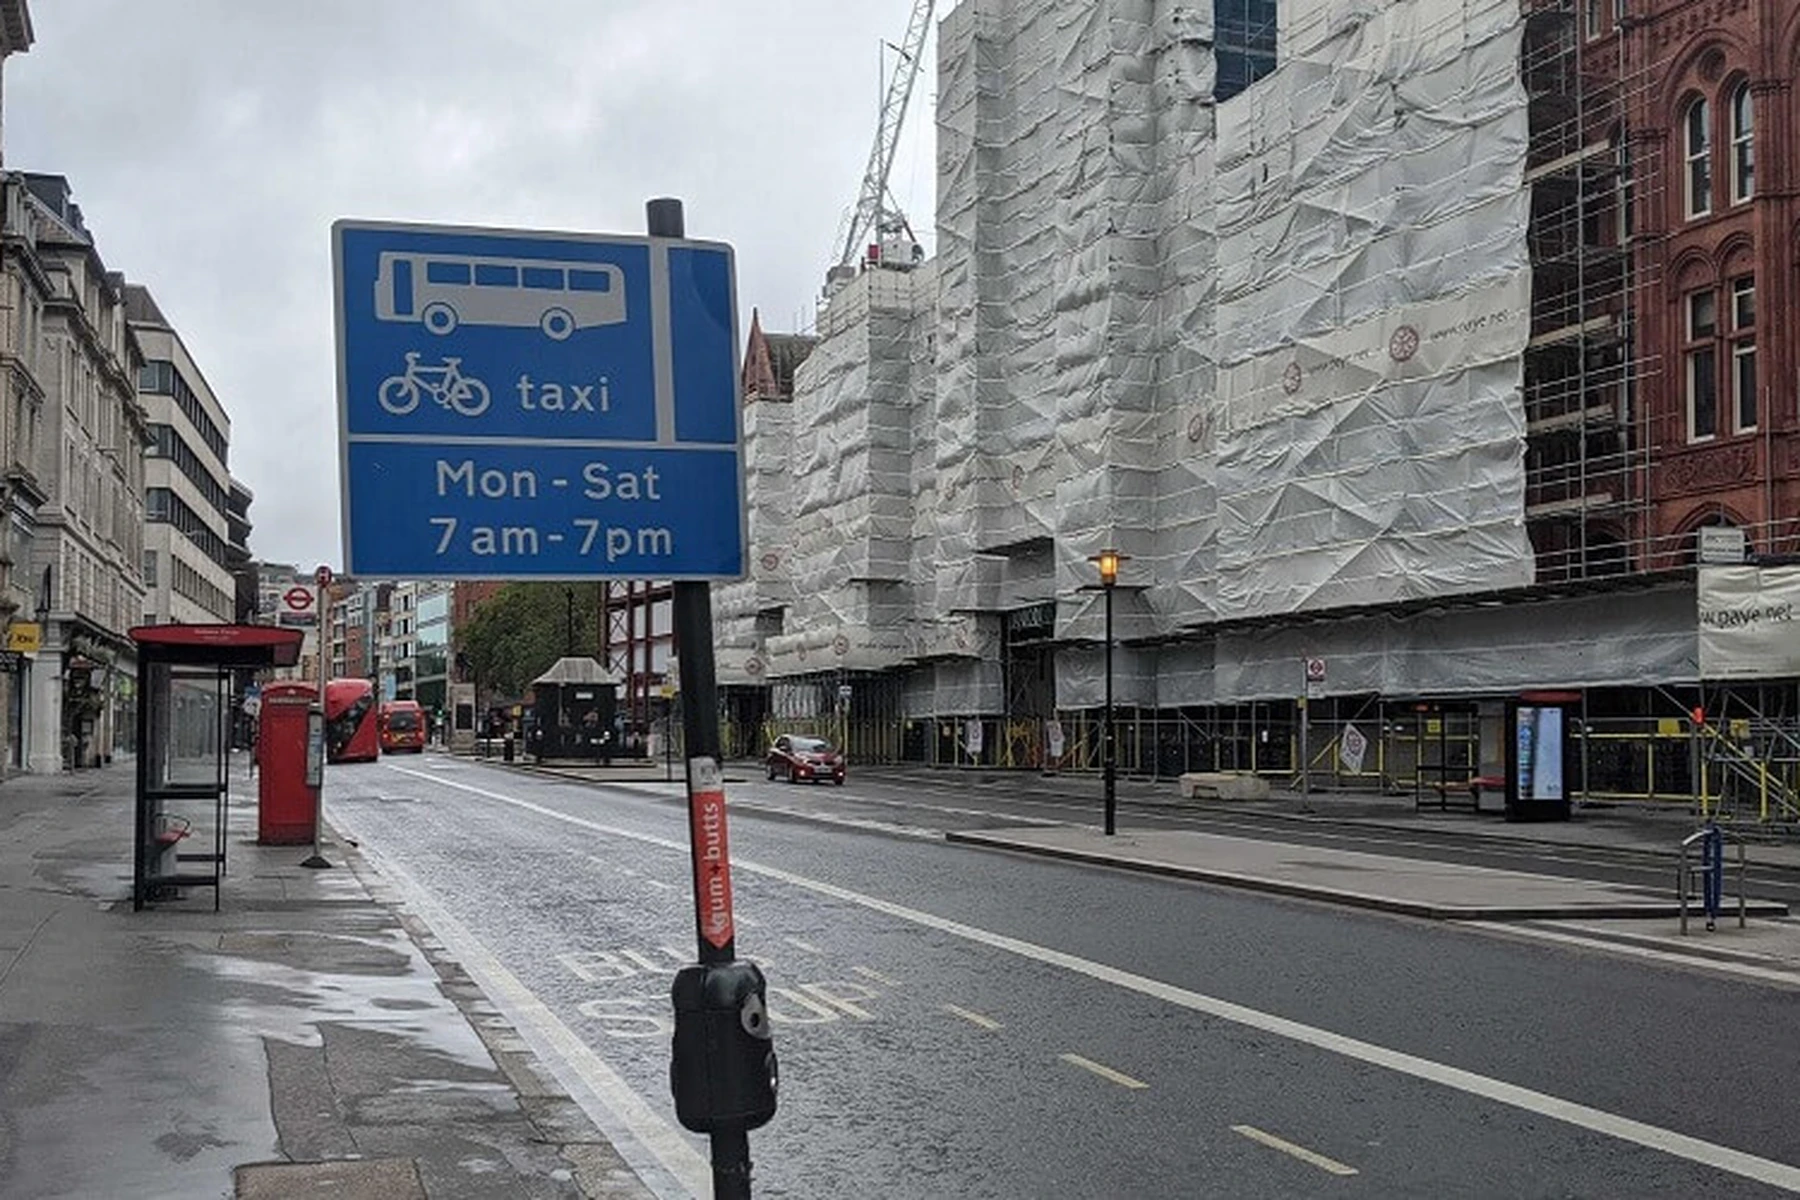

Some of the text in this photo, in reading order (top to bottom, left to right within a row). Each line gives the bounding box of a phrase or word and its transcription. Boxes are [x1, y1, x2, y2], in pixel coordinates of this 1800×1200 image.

[517, 374, 610, 413] taxi
[436, 459, 537, 498] Mon
[582, 463, 662, 501] Sat
[703, 802, 721, 862] butts
[579, 981, 881, 1038] SOP
